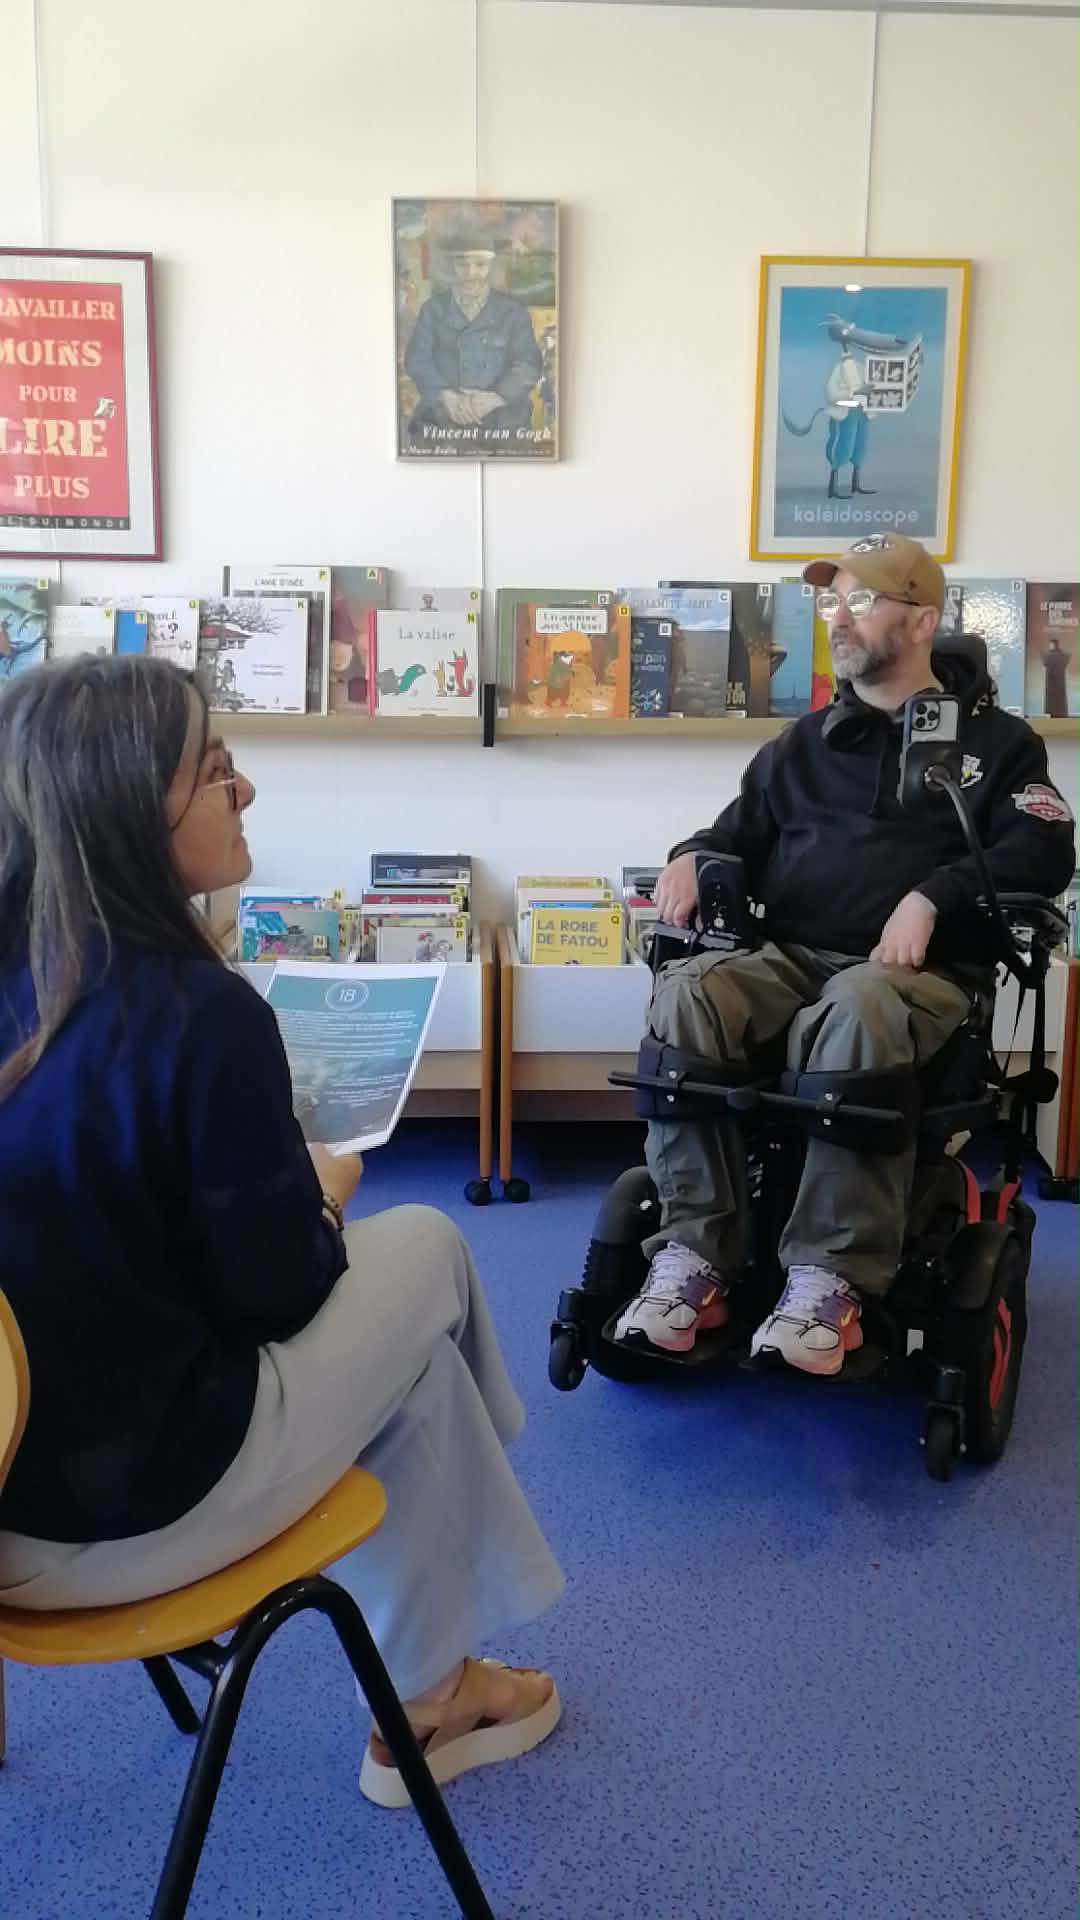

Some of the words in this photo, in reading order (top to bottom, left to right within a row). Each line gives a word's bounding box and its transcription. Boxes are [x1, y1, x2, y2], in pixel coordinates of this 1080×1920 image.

[0, 298, 116, 320] AVAILLER
[19, 384, 78, 402] POUR
[0, 416, 108, 457] LIRE
[424, 426, 479, 440] Vincent
[484, 429, 510, 440] van
[516, 427, 552, 443] Gogh
[14, 475, 90, 499] PLUS
[399, 627, 414, 640] La
[417, 627, 457, 640] valise
[537, 919, 556, 931] LA
[560, 919, 599, 933] ROBE
[536, 932, 555, 945] DE
[560, 934, 609, 949] FATOU
[339, 988, 357, 1003] 18
